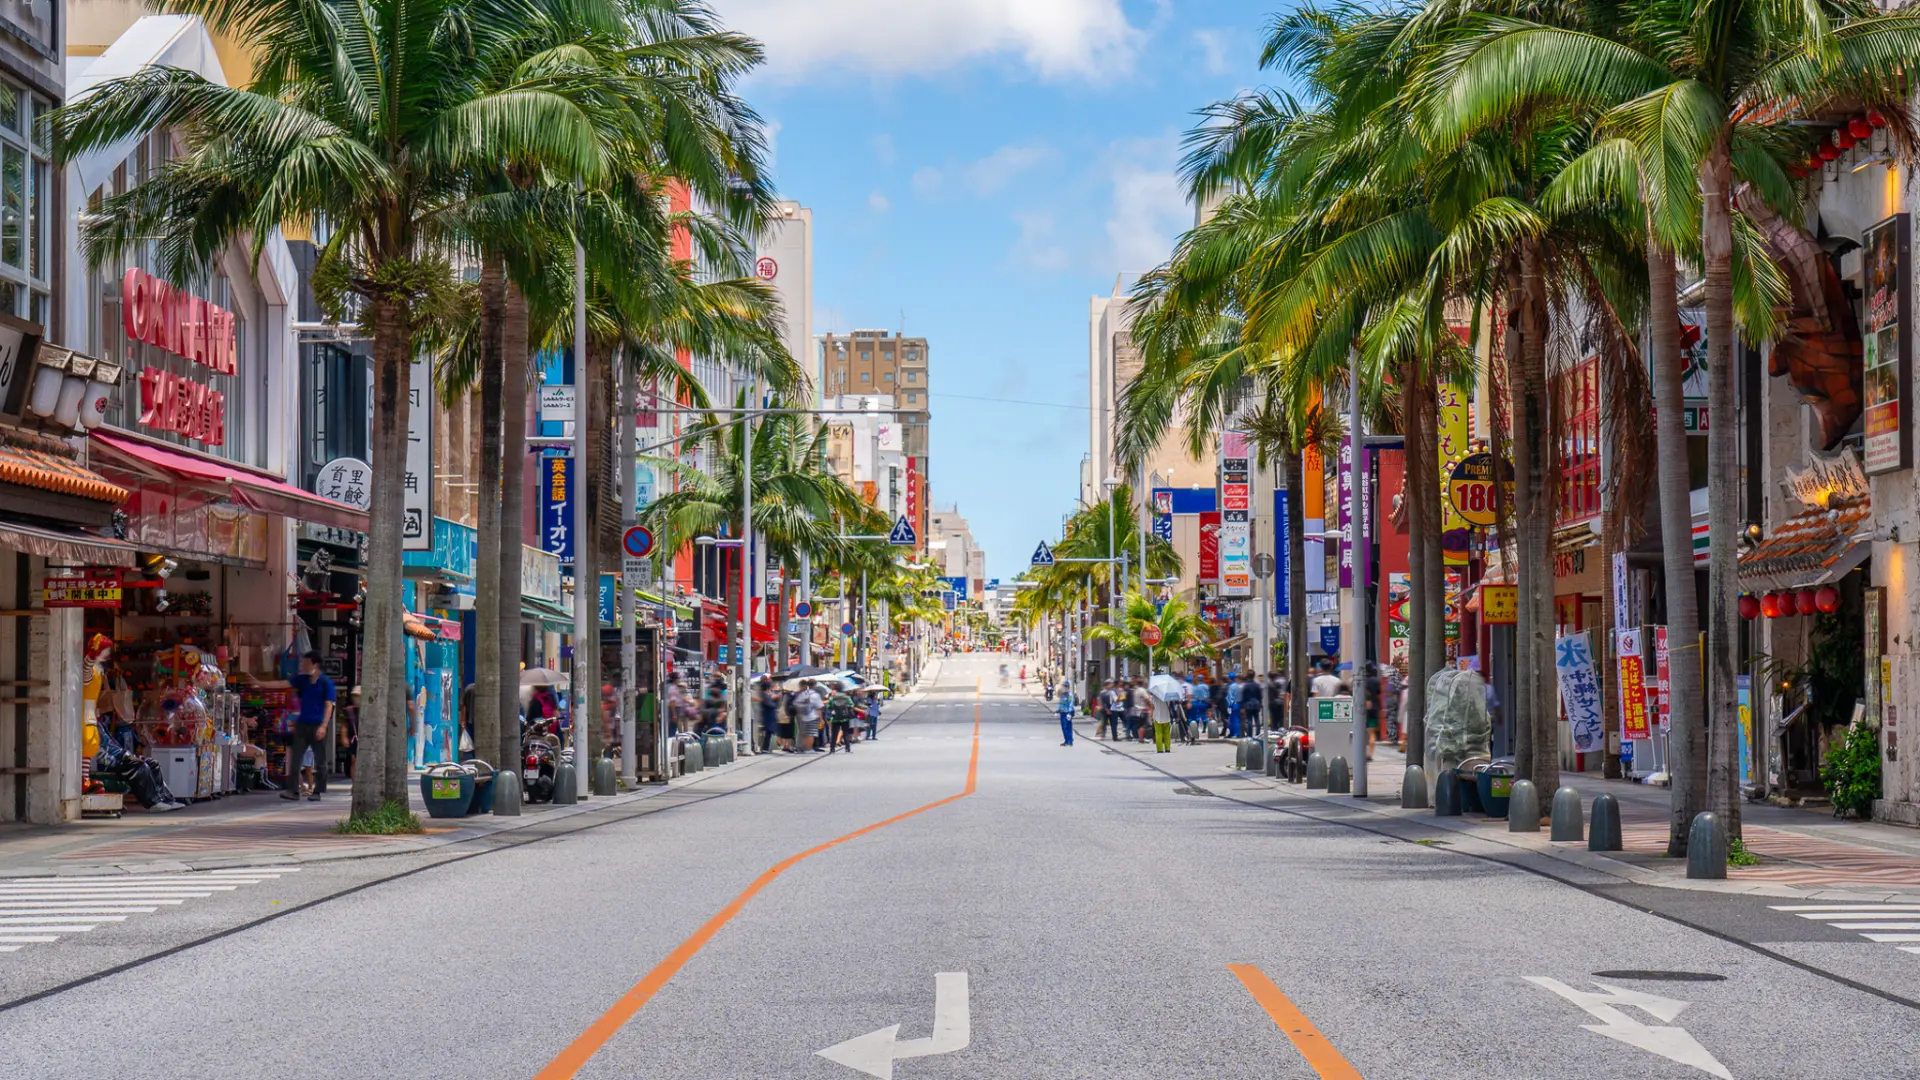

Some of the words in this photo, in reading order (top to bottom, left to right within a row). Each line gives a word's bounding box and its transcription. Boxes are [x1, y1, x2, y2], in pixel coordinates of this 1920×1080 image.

[331, 465, 364, 486] 首里
[551, 459, 567, 501] 英会話
[1464, 463, 1493, 475] PREMI
[550, 501, 568, 554] イーオン
[1485, 610, 1516, 618] ちんすこう
[1629, 659, 1645, 729] たばこ・酒類
